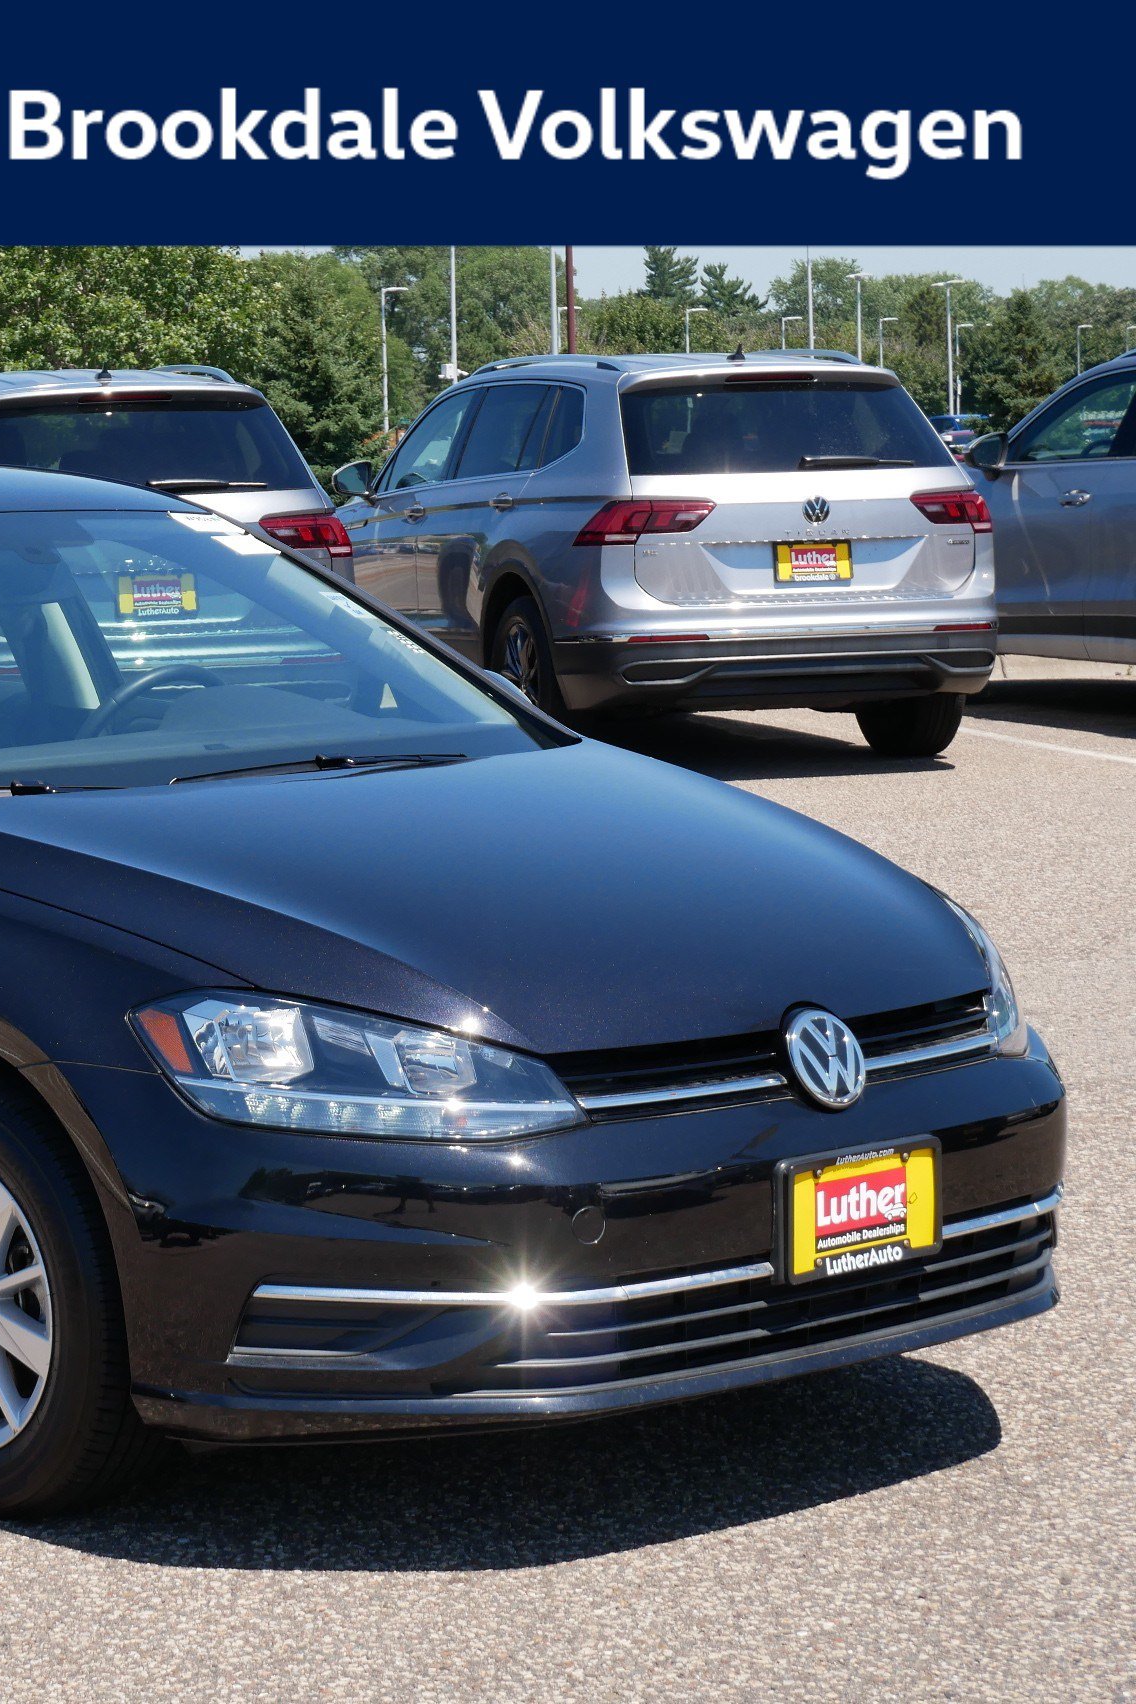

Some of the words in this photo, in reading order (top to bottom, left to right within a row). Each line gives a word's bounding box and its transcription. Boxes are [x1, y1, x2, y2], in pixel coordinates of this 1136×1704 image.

[791, 551, 836, 565] Luther
[794, 574, 829, 582] brookdale
[133, 583, 181, 598] Luther
[138, 608, 179, 616] LutherAuto
[835, 1148, 895, 1166] LutherAuto.com
[816, 1181, 905, 1227] Luther
[817, 1231, 862, 1250] Automobile
[862, 1223, 905, 1240] Dealerships
[825, 1244, 903, 1276] LutherAuto
